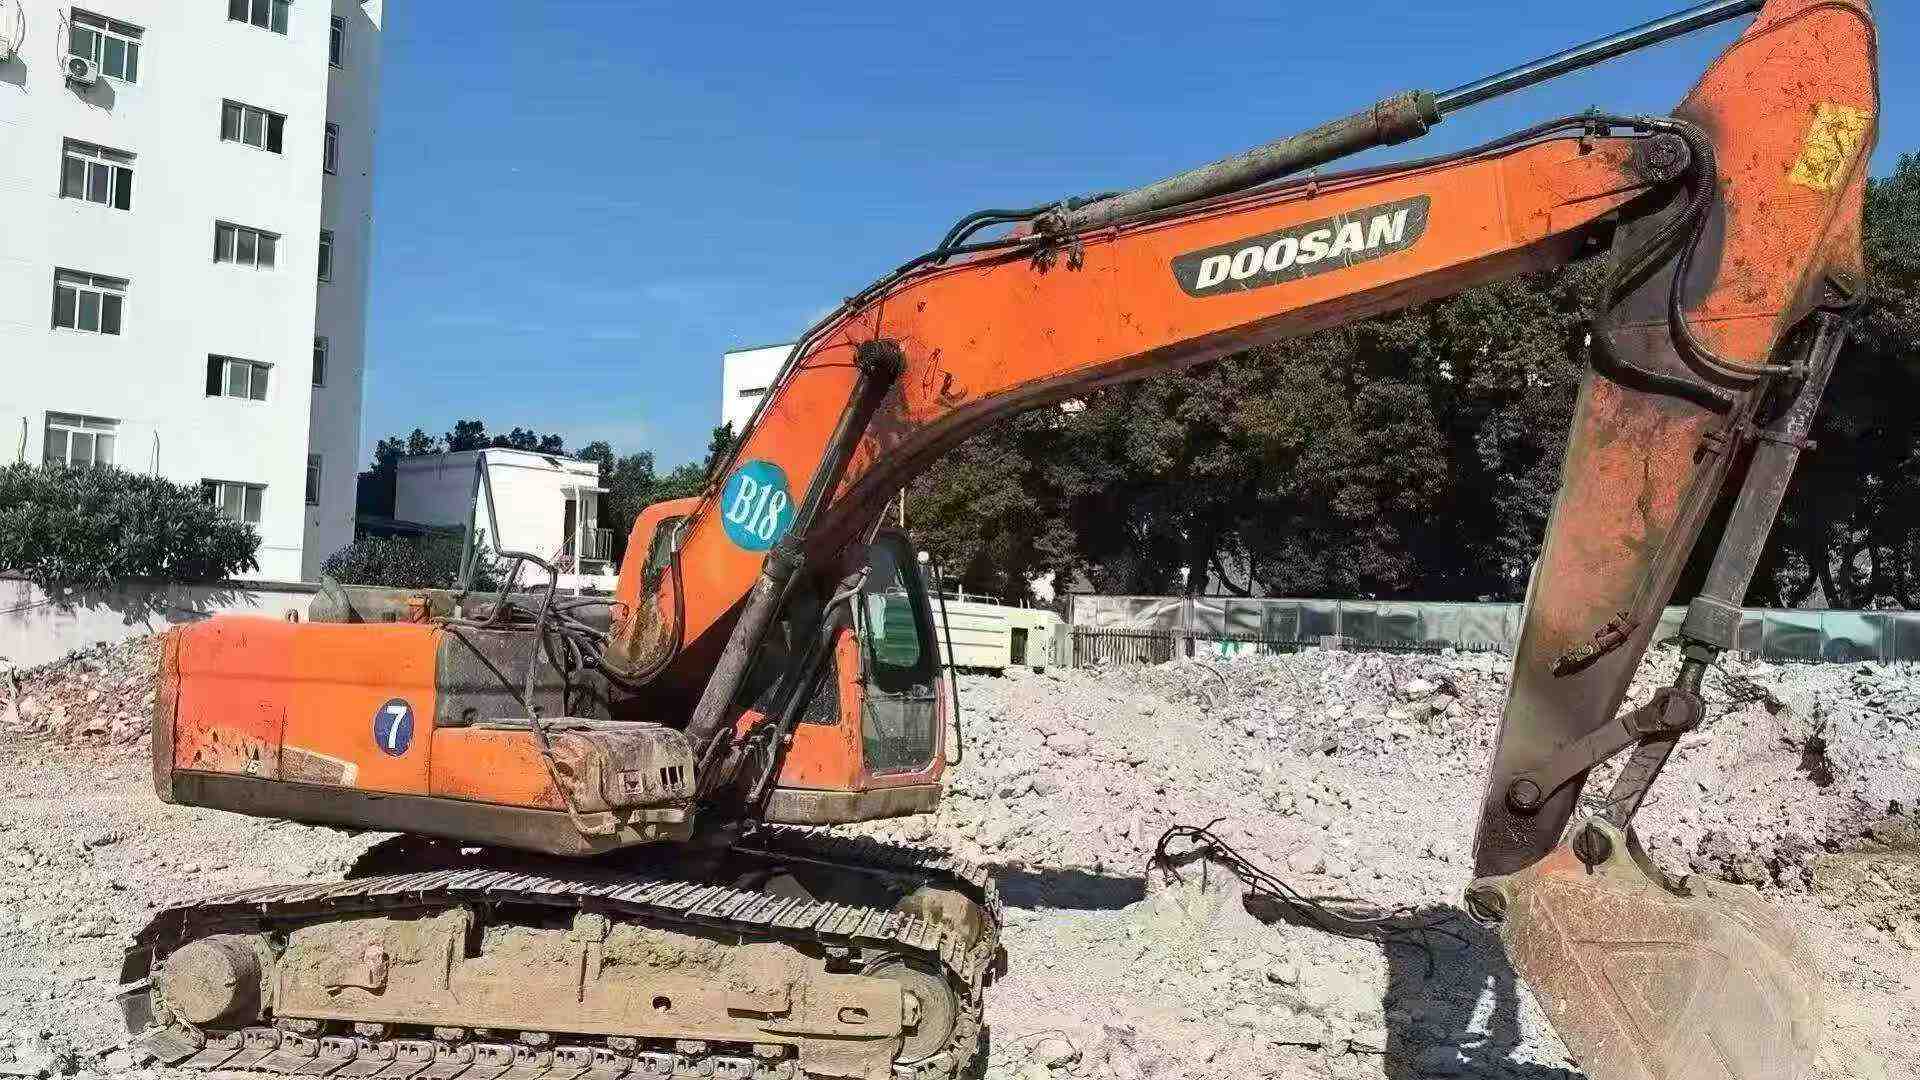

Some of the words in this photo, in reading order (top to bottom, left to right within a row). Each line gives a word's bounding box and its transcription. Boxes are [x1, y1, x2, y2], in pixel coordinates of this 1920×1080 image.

[1196, 209, 1409, 290] DOOSAN
[725, 475, 787, 540] B18
[386, 705, 407, 749] 7
